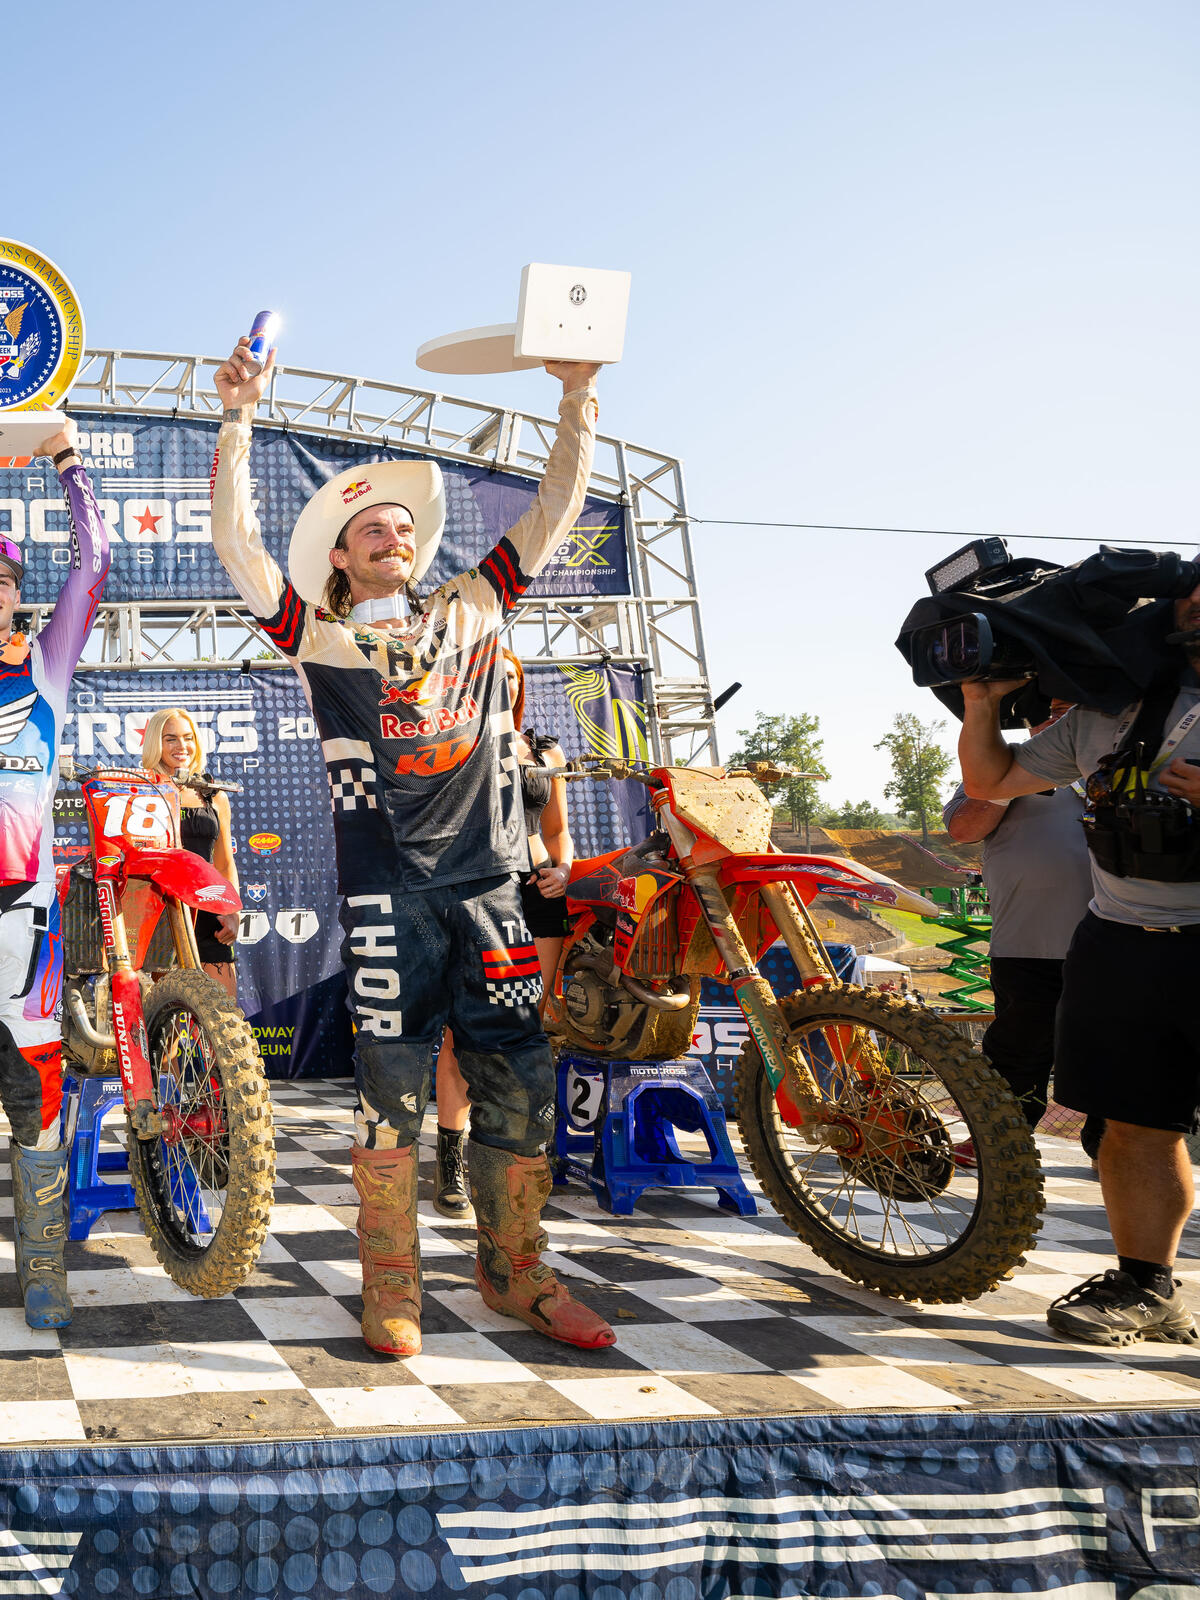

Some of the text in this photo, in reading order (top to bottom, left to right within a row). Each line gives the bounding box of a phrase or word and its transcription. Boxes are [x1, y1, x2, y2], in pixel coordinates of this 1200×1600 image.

[24, 253, 80, 361] CHAMPIONSHIP
[82, 458, 135, 469] ACING
[343, 484, 373, 504] Red Bull
[552, 569, 616, 577] CHAMPIONSHIP
[380, 693, 481, 739] Red Bull
[103, 795, 172, 838] 18
[347, 894, 403, 1037] THOR
[113, 1001, 134, 1085] DUNLOP
[748, 1014, 782, 1073] MOTOREX
[571, 1077, 591, 1120] 2
